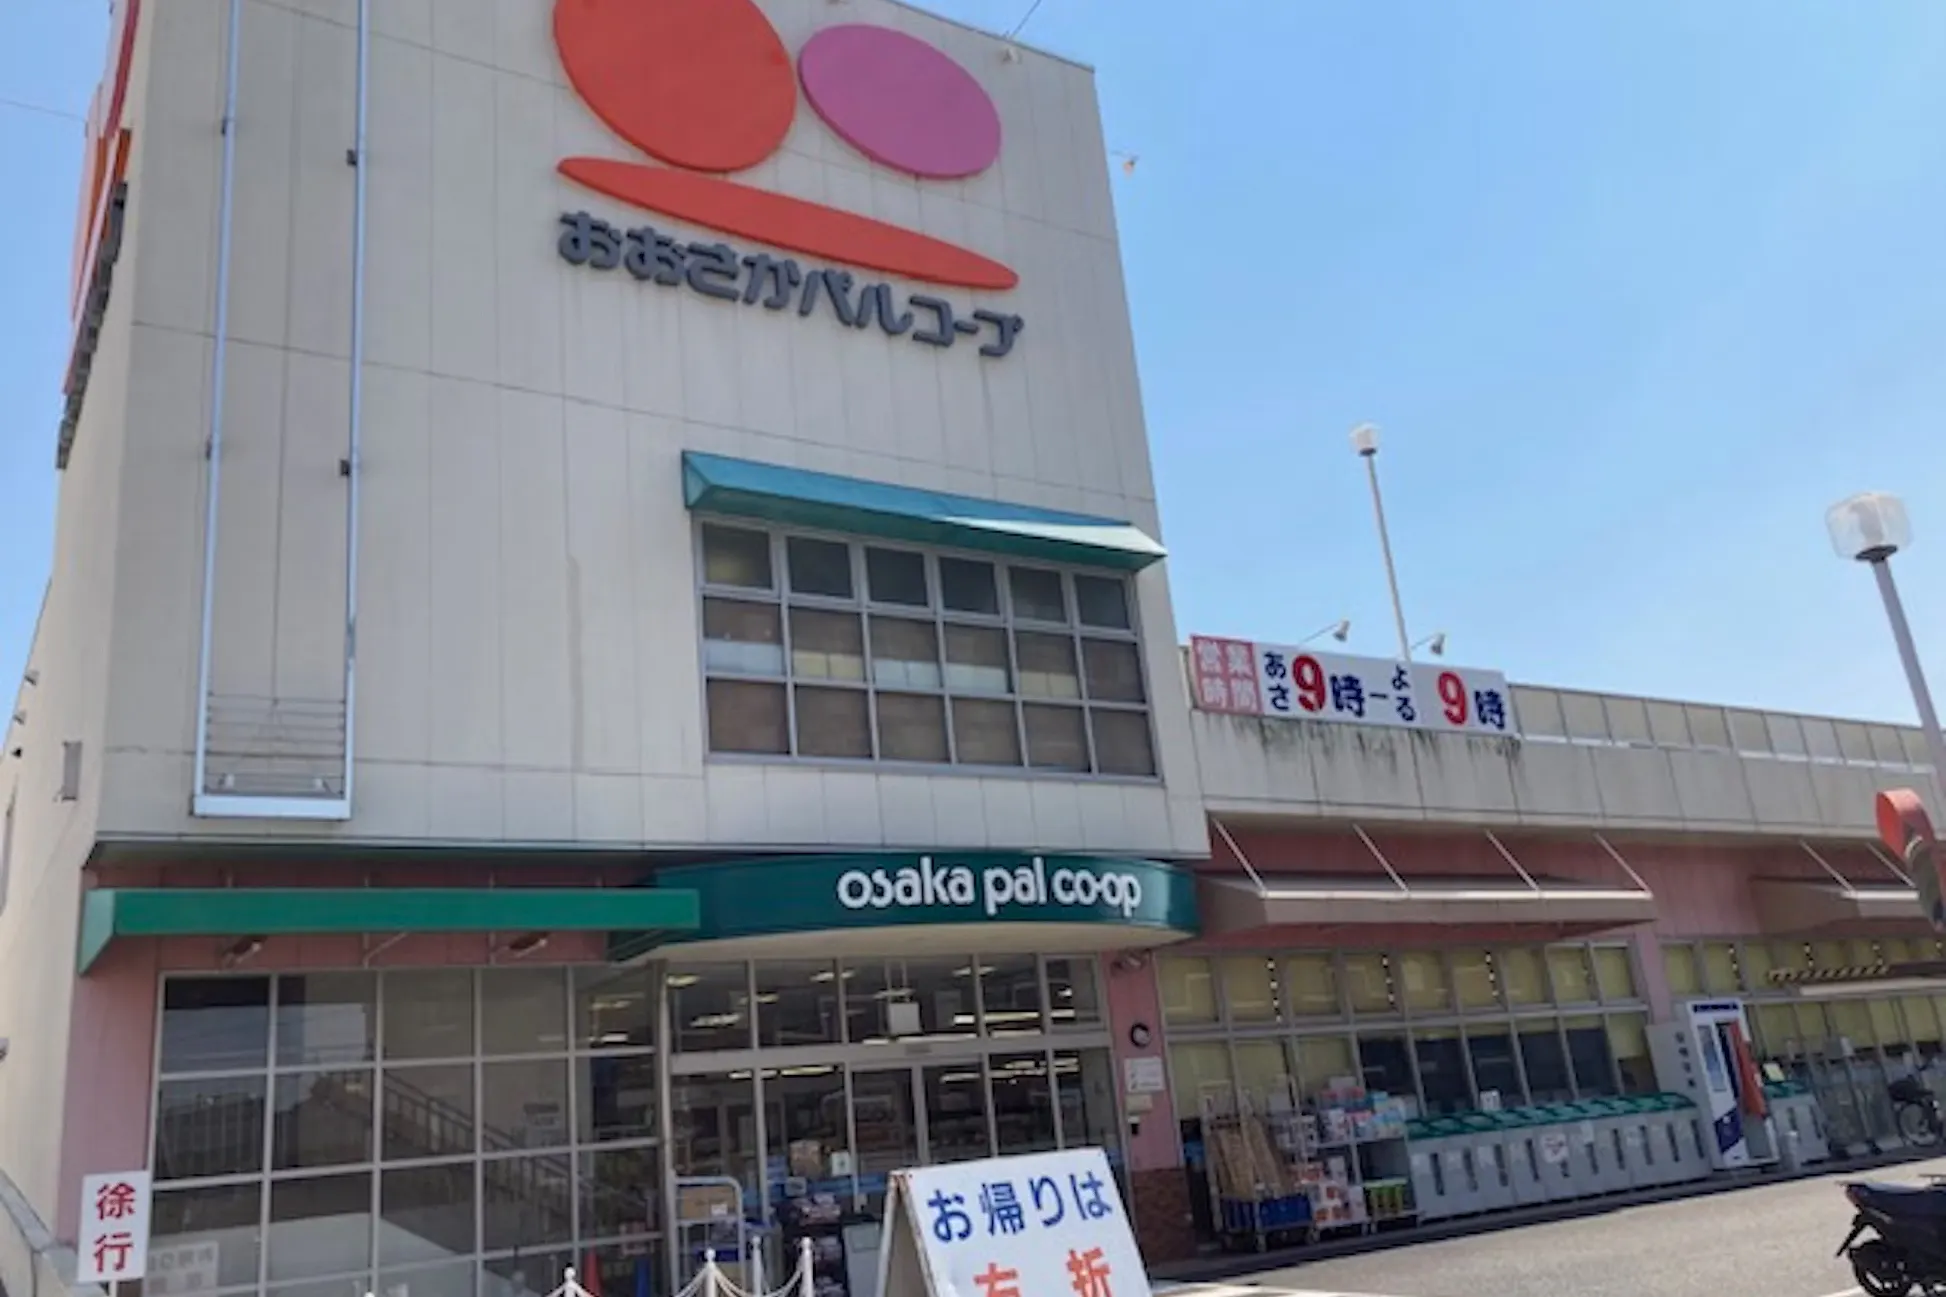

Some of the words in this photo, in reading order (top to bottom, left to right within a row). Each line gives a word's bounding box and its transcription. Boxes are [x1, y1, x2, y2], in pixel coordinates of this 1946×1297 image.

[558, 210, 1024, 357] おおさかパルコープ
[837, 857, 974, 908] osaka
[984, 857, 1045, 915] pal
[94, 1182, 136, 1272] 徐行
[927, 1171, 1112, 1243] お帰りは
